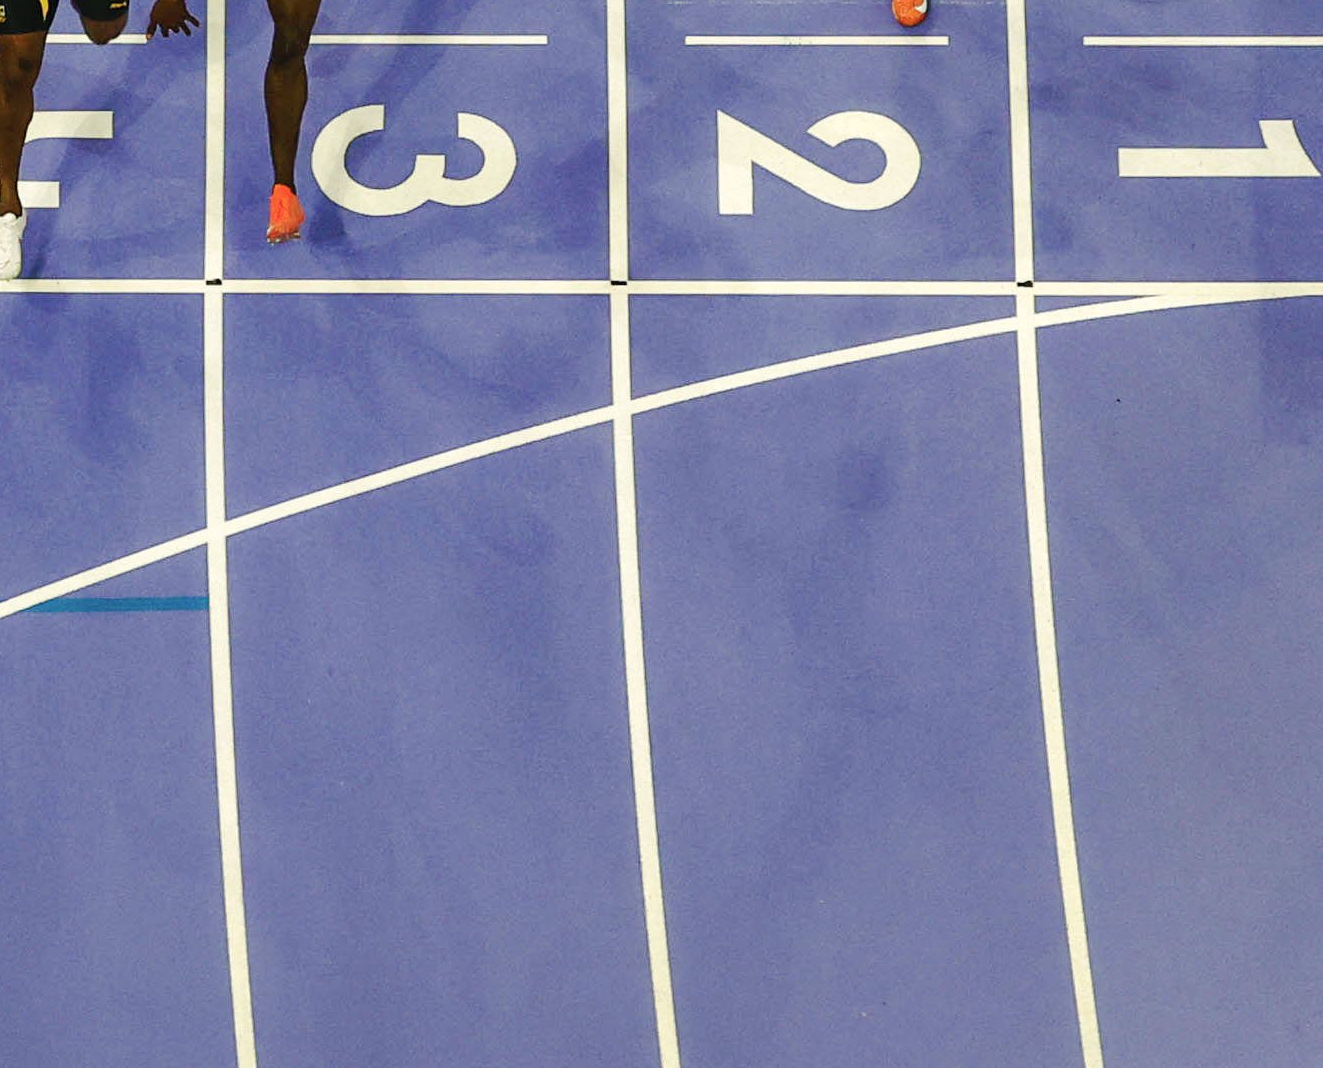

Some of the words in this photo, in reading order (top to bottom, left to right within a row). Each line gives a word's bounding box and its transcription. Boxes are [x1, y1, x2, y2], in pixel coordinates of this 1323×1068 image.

[311, 104, 517, 216] 3
[716, 110, 921, 215] 2
[1118, 119, 1322, 178] 1
